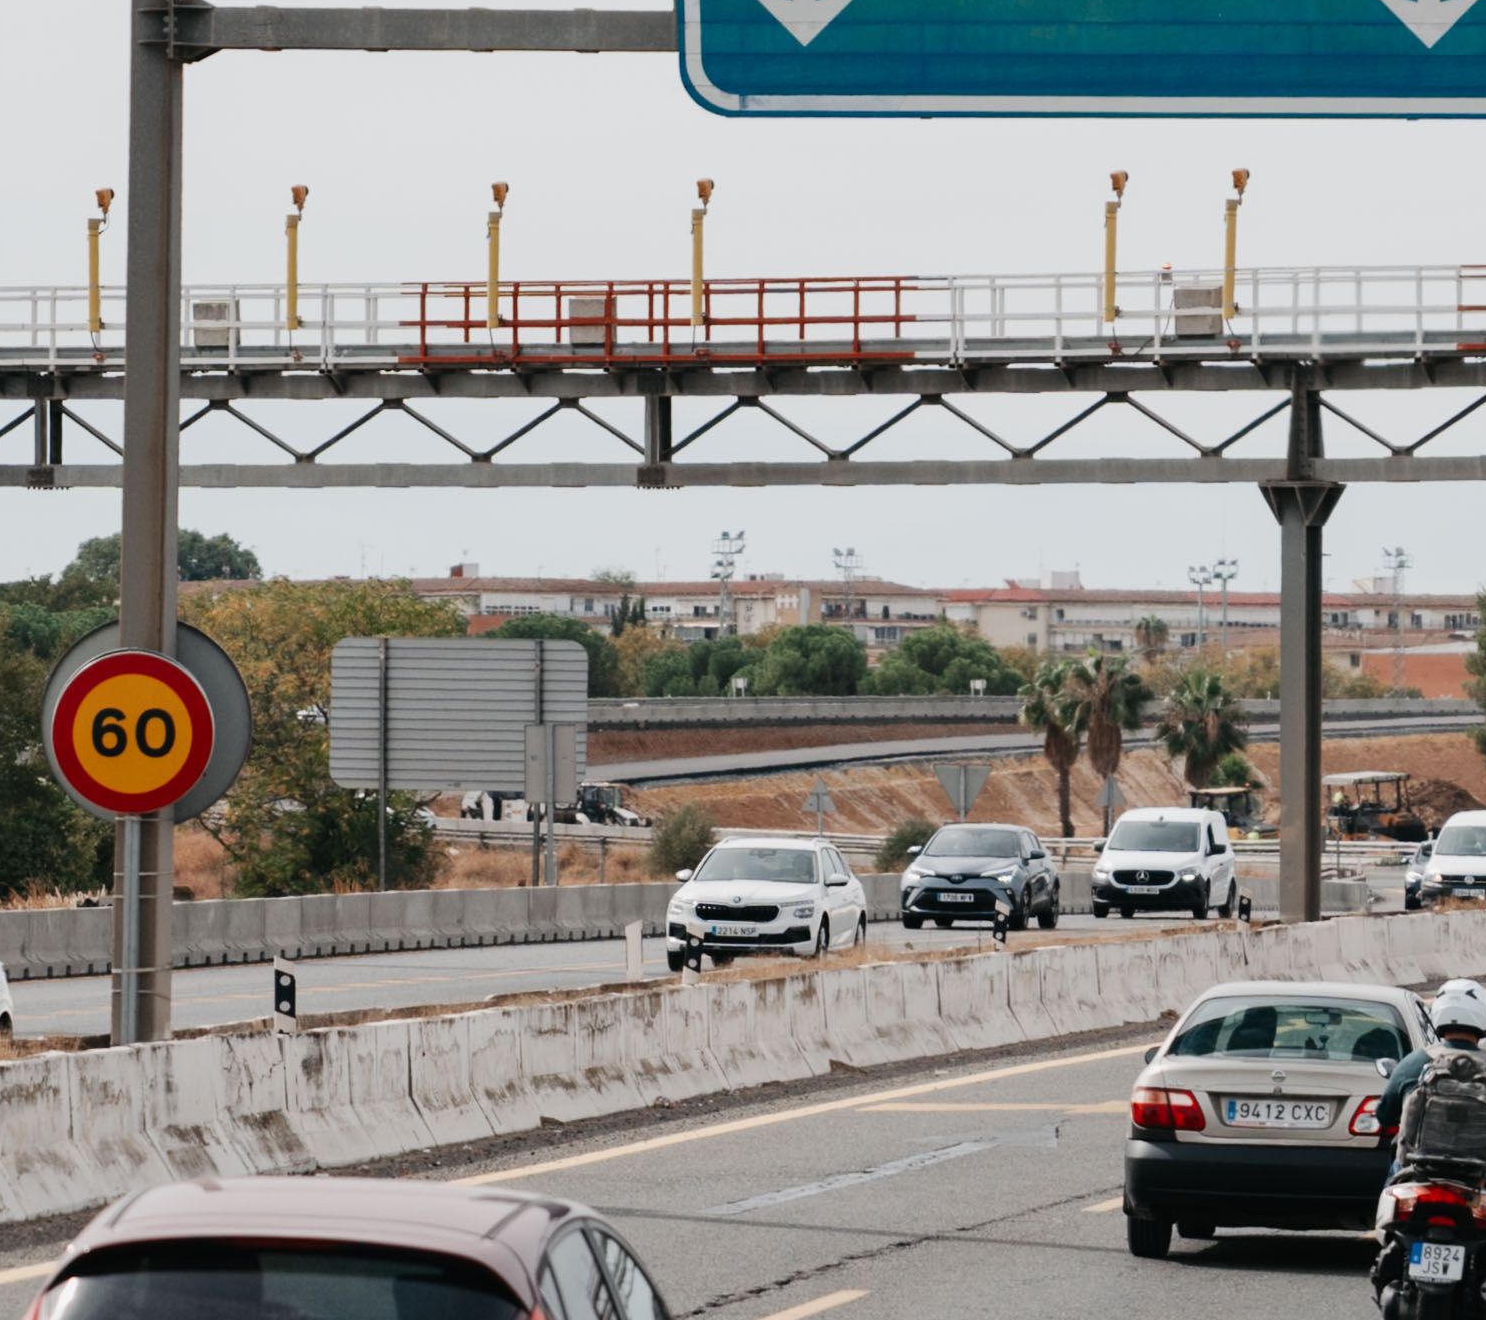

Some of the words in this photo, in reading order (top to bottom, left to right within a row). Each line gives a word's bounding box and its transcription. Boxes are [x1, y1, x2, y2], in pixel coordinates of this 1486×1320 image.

[91, 707, 176, 758] 60
[1239, 1102, 1285, 1120] 9412
[1291, 1104, 1326, 1121] CXC
[1423, 1245, 1460, 1263] 8924
